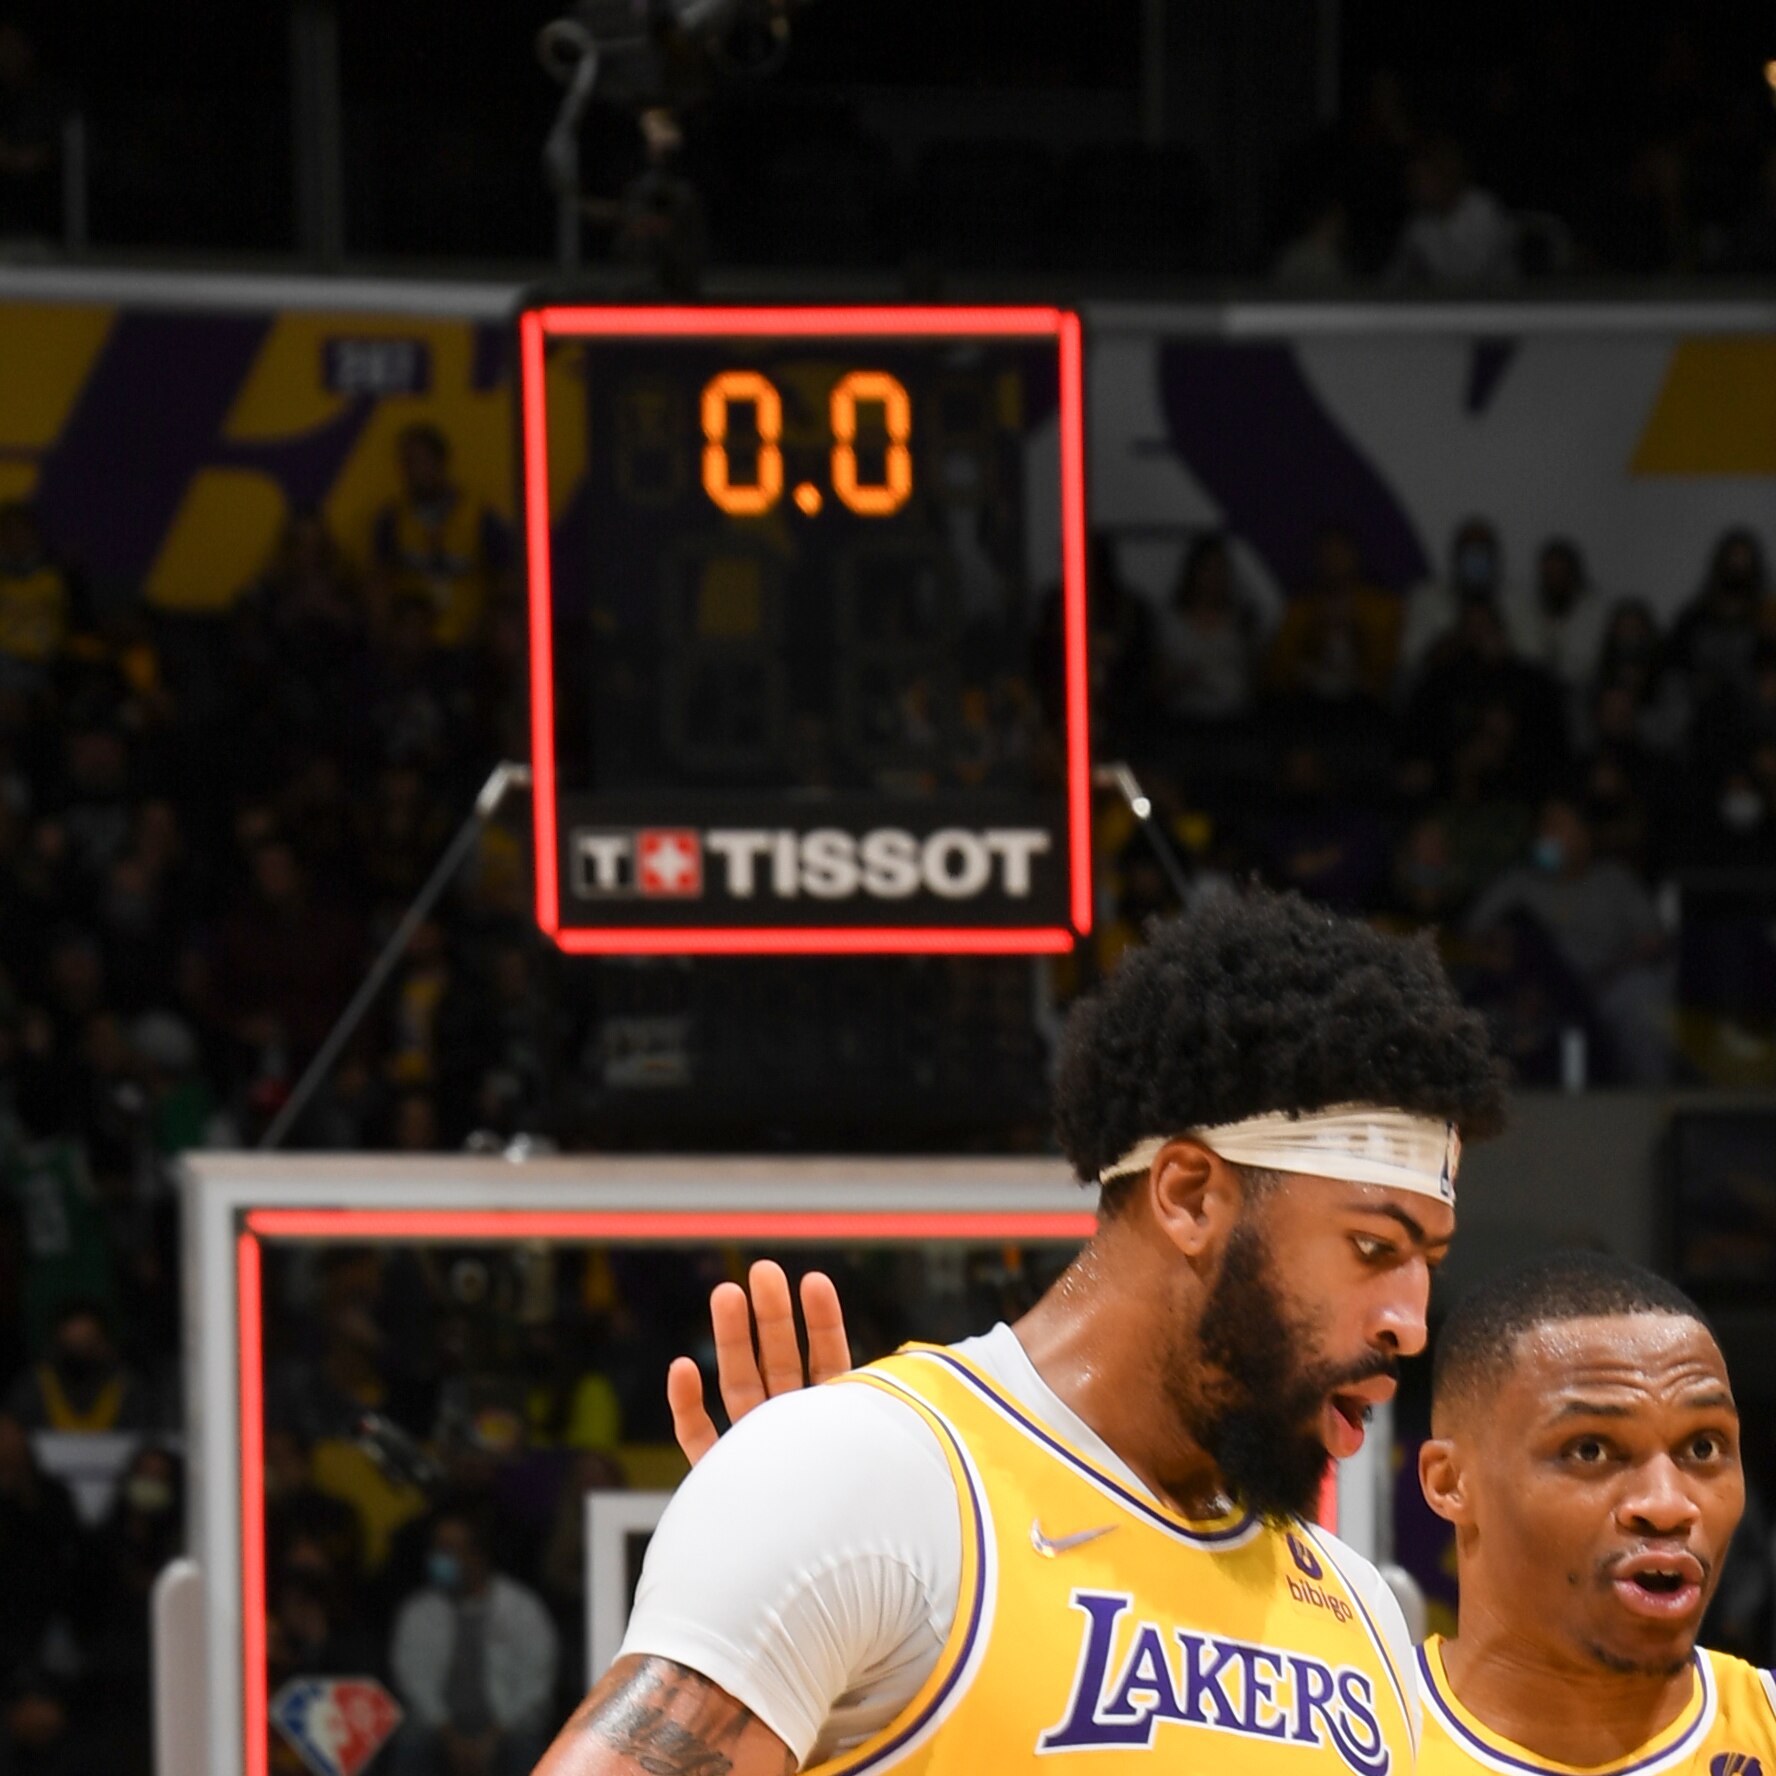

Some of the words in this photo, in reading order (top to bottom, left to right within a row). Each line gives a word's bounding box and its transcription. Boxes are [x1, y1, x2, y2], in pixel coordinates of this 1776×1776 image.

[700, 368, 913, 518] 0.0
[705, 827, 1052, 899] TISSOT
[1285, 1573, 1354, 1624] bibigo
